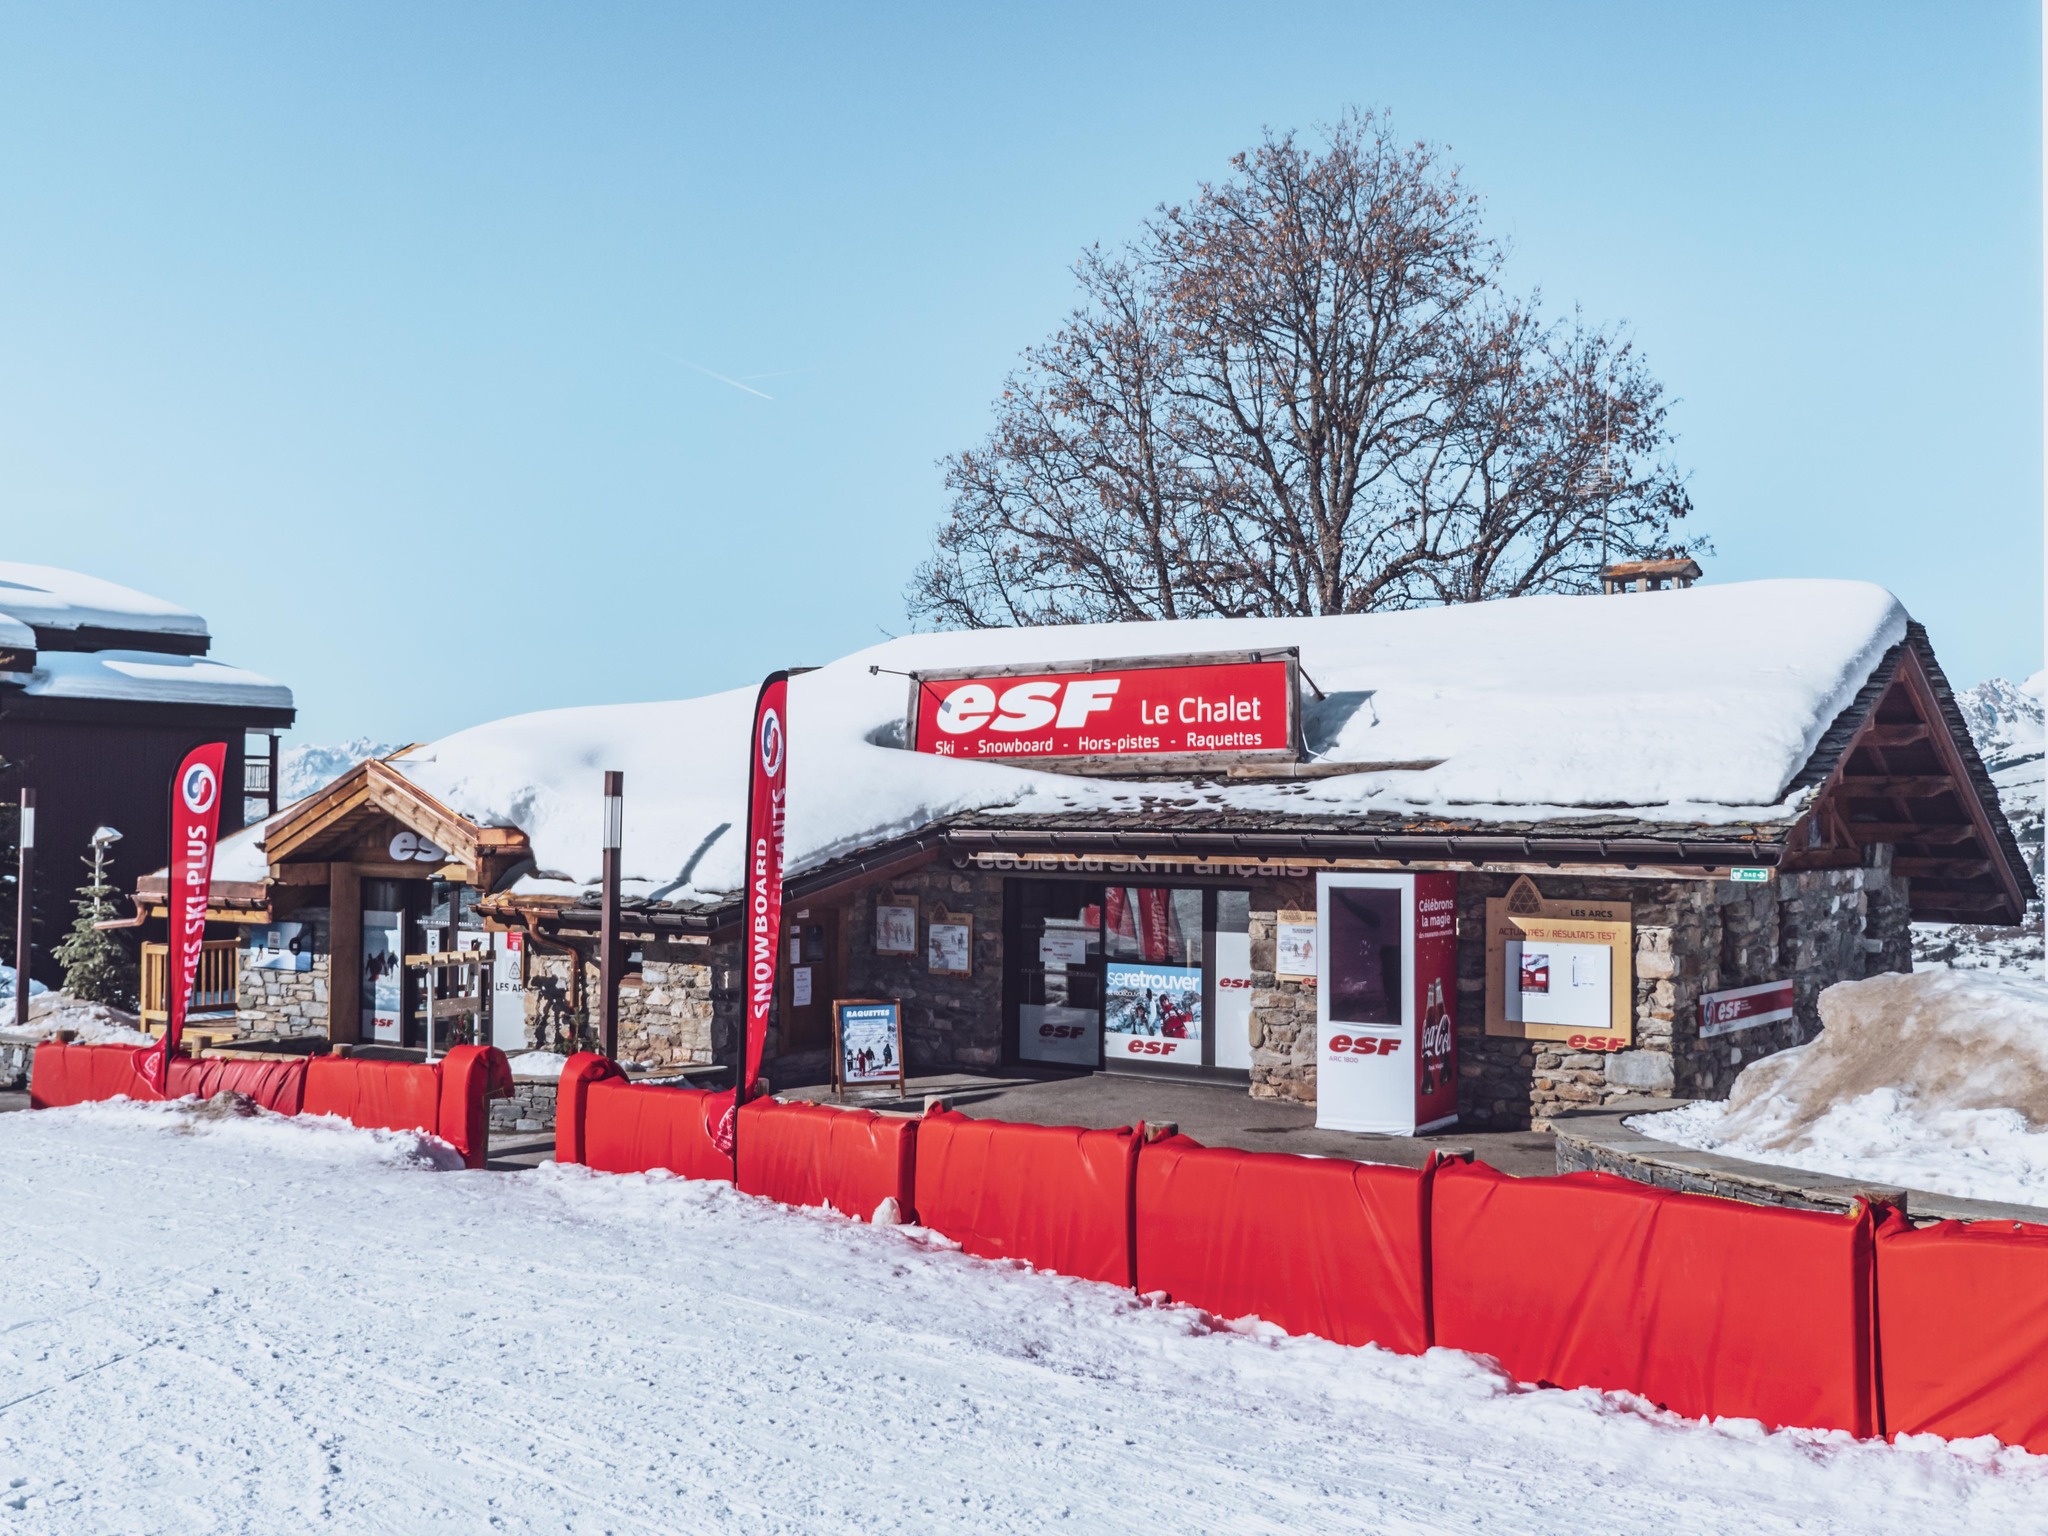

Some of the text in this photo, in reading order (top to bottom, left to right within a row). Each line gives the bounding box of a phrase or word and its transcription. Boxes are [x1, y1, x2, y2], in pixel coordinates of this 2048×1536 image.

[1141, 694, 1262, 725] Le Chalet
[935, 739, 955, 755] Ski
[978, 737, 1054, 755] Snowboard
[1078, 734, 1160, 752] Hors-pistes
[1186, 731, 1262, 749] Raquettes
[389, 831, 462, 862] es
[185, 825, 208, 935] SKI-PLUS
[1418, 898, 1454, 912] Célébrons
[1421, 911, 1451, 928] la magie
[1589, 910, 1613, 918] ARCS
[753, 838, 773, 1019] SNOWBOARD
[1498, 927, 1545, 937] ACTUALITÉS
[1552, 929, 1595, 939] RÉSULTATS
[1597, 932, 1617, 941] TEST
[495, 983, 509, 992] LES
[846, 1008, 890, 1018] RAQUETTES
